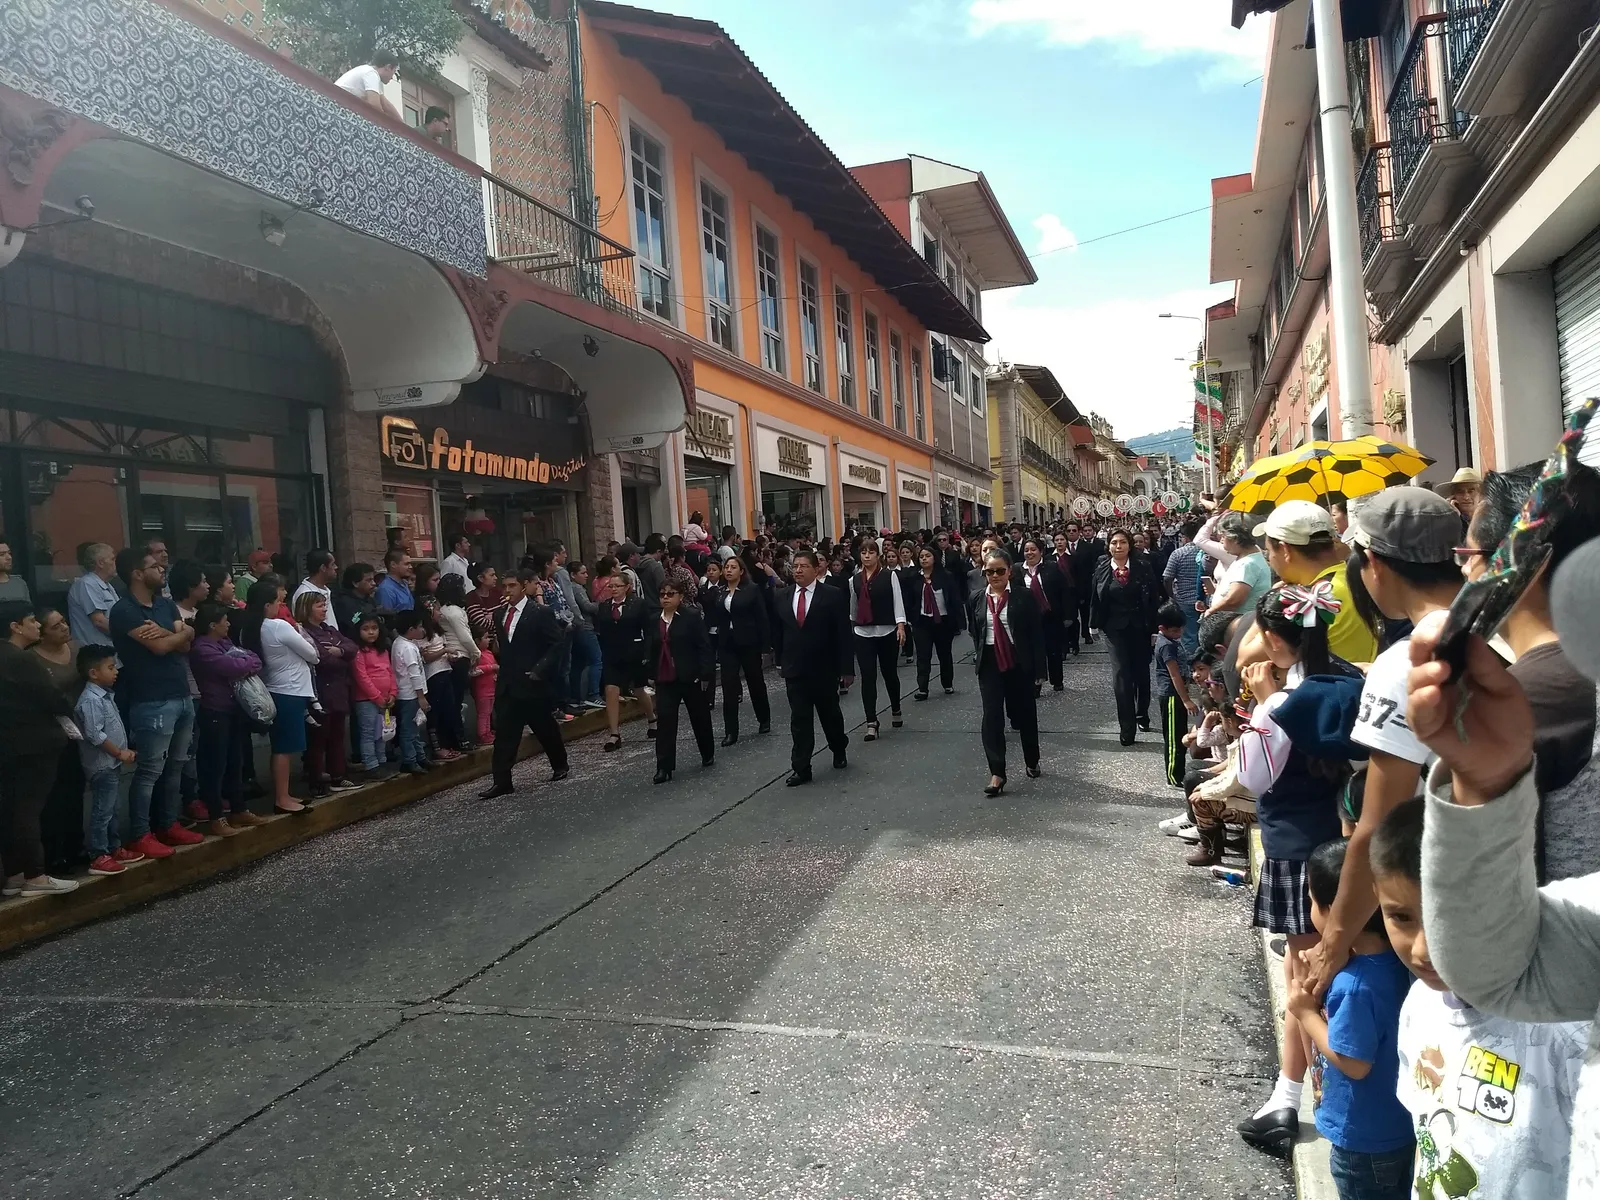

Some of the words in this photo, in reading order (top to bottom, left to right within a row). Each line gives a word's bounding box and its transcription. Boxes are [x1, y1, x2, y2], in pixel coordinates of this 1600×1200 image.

[428, 427, 550, 484] fotomundo
[550, 452, 587, 482] Digital
[1460, 1045, 1521, 1095] BEN
[1457, 1074, 1516, 1125] 10
